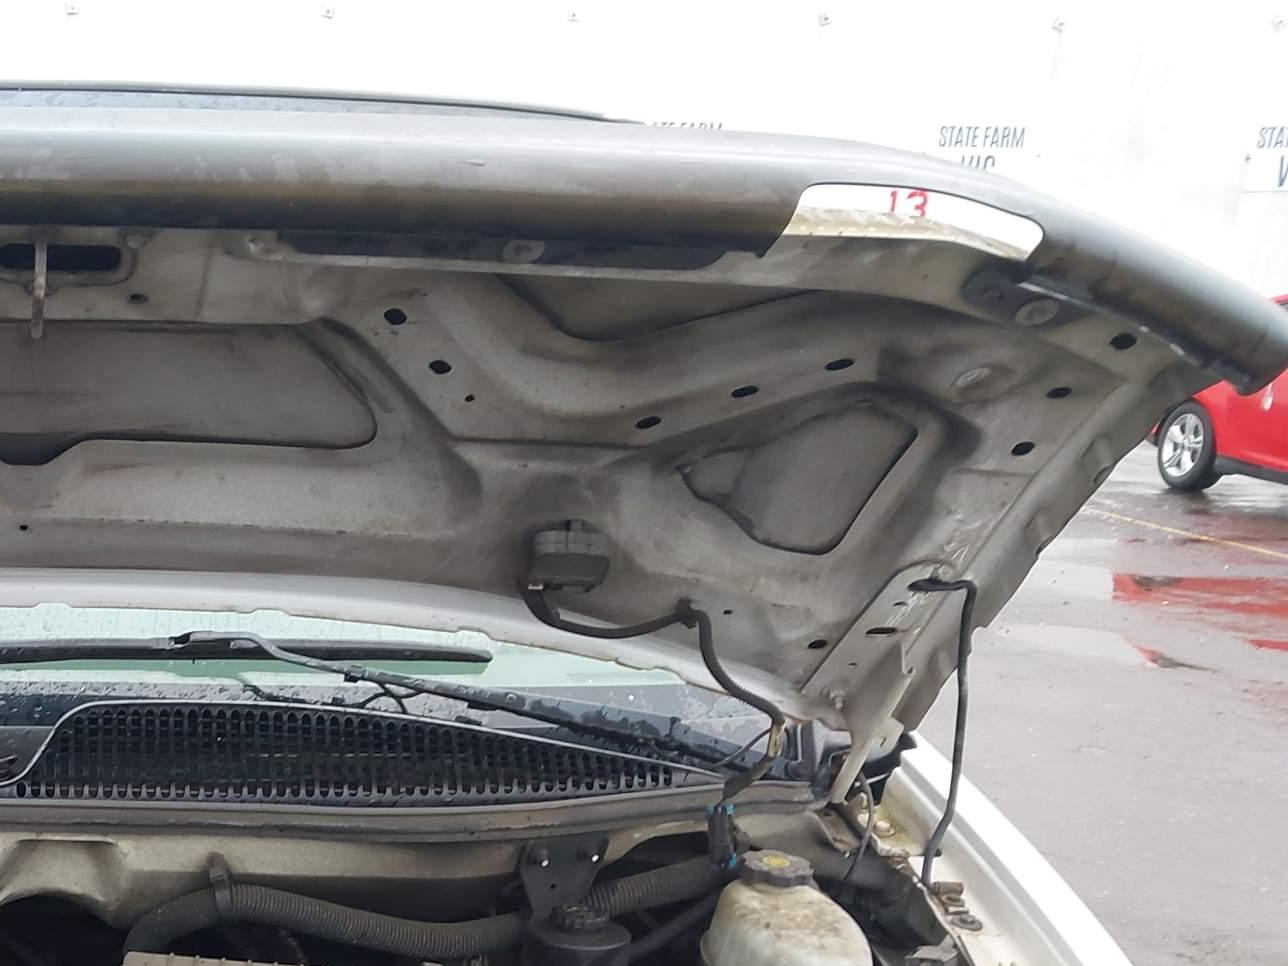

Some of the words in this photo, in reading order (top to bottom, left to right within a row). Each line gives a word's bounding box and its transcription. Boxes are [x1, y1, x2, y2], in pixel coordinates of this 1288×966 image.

[938, 125, 979, 148] STATE
[982, 126, 1026, 149] FARM
[1256, 126, 1288, 149] STA
